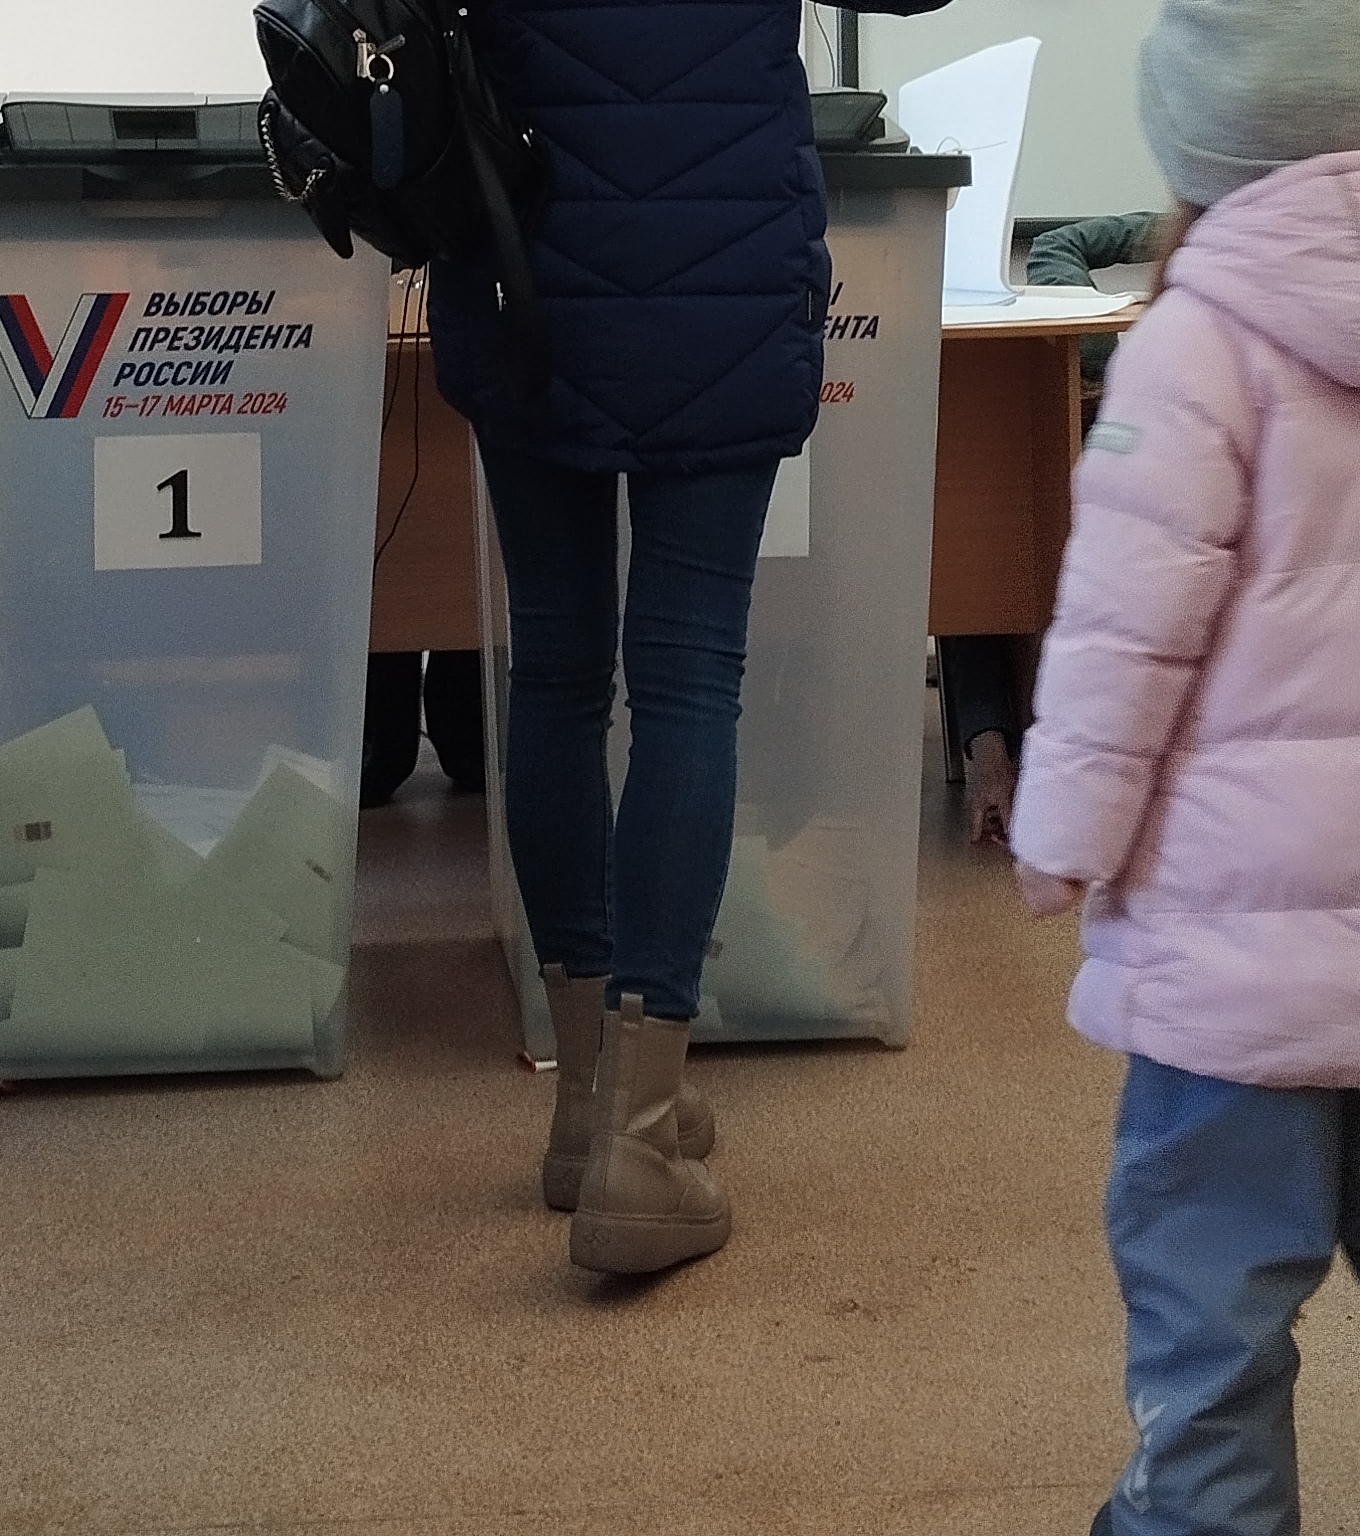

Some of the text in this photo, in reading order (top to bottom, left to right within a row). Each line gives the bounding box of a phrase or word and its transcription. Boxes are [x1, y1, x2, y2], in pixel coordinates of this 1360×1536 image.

[143, 290, 276, 318] ВЫБОРЫ
[128, 324, 315, 353] ПРЕЗИДЕНТА
[113, 360, 235, 387] РОССИИ
[162, 394, 234, 417] МАРТА
[237, 392, 289, 416] 2024
[820, 381, 855, 403] 024
[156, 469, 202, 540] 1
